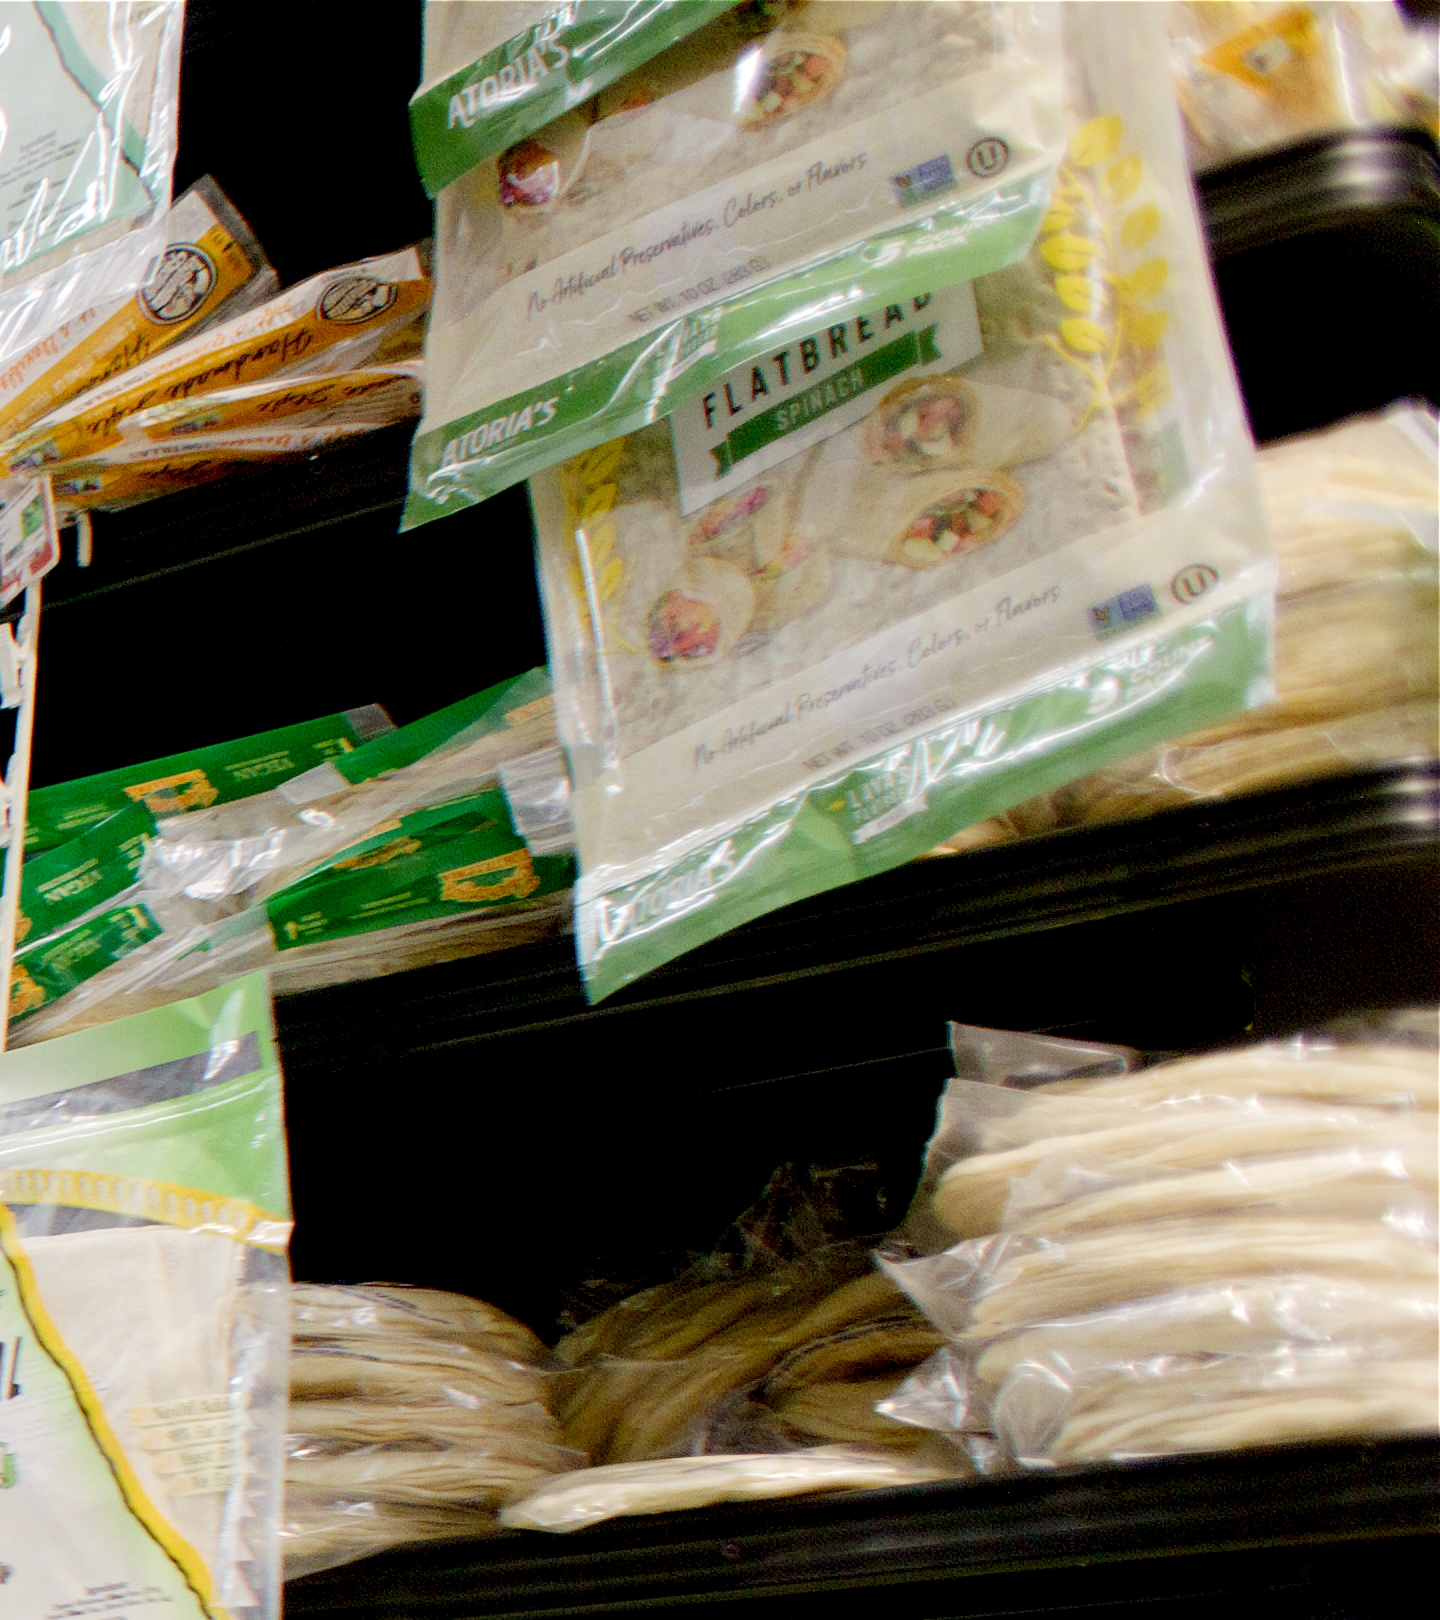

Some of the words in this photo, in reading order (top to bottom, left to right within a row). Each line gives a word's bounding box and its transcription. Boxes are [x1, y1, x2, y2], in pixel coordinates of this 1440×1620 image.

[447, 31, 573, 131] ATORIA'S
[525, 291, 549, 321] No
[550, 261, 619, 304] Artificial
[806, 150, 869, 194] Flavors
[441, 396, 560, 470] ATORIA'S
[774, 364, 866, 434] SPINACH
[693, 739, 721, 765] No
[722, 707, 793, 756] Artificial
[996, 585, 1061, 628] Flavors
